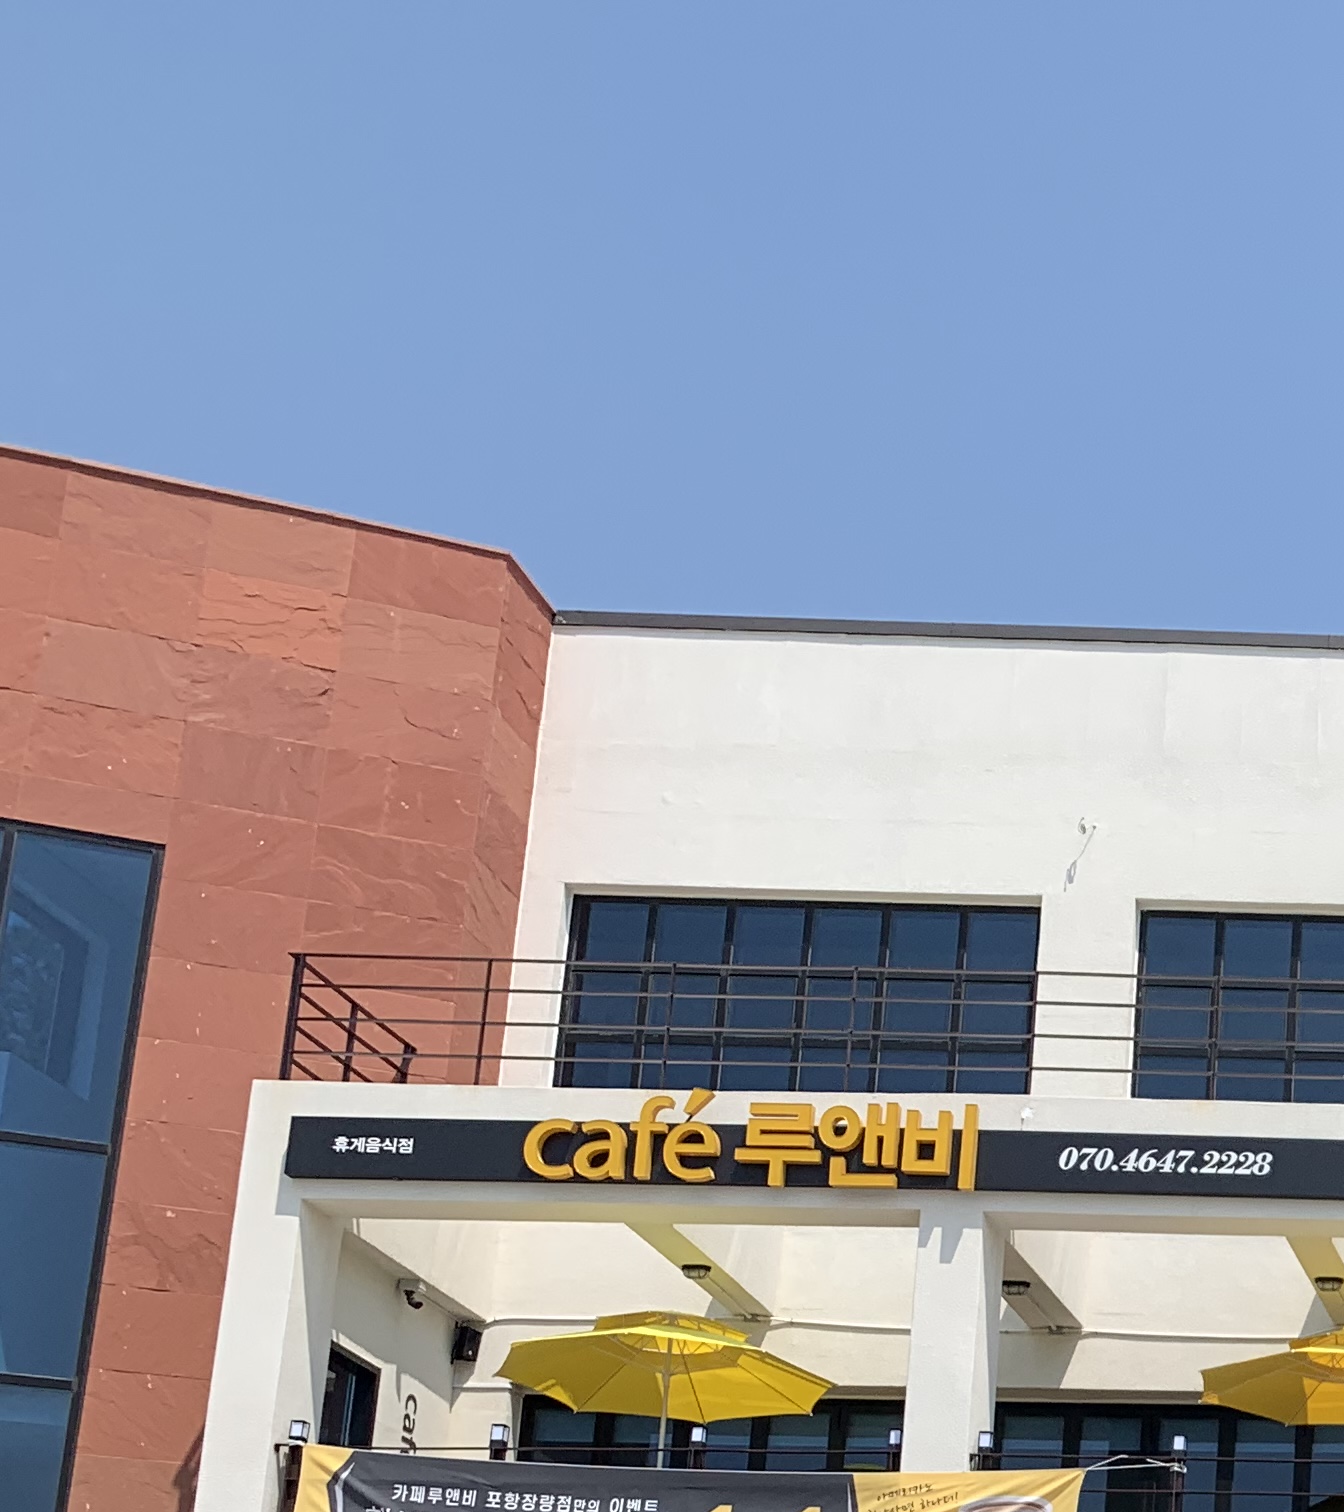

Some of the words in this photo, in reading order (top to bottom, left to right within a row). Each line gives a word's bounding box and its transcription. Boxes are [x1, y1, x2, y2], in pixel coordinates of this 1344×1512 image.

[332, 1136, 414, 1154] 휴게음식점
[523, 1087, 721, 1182] café
[735, 1101, 979, 1191] 루앤비
[1058, 1146, 1273, 1176] 070.4647.2228
[400, 1393, 417, 1455] caf
[391, 1483, 478, 1508] 카페루앤비
[877, 1483, 932, 1501] 아메리카노
